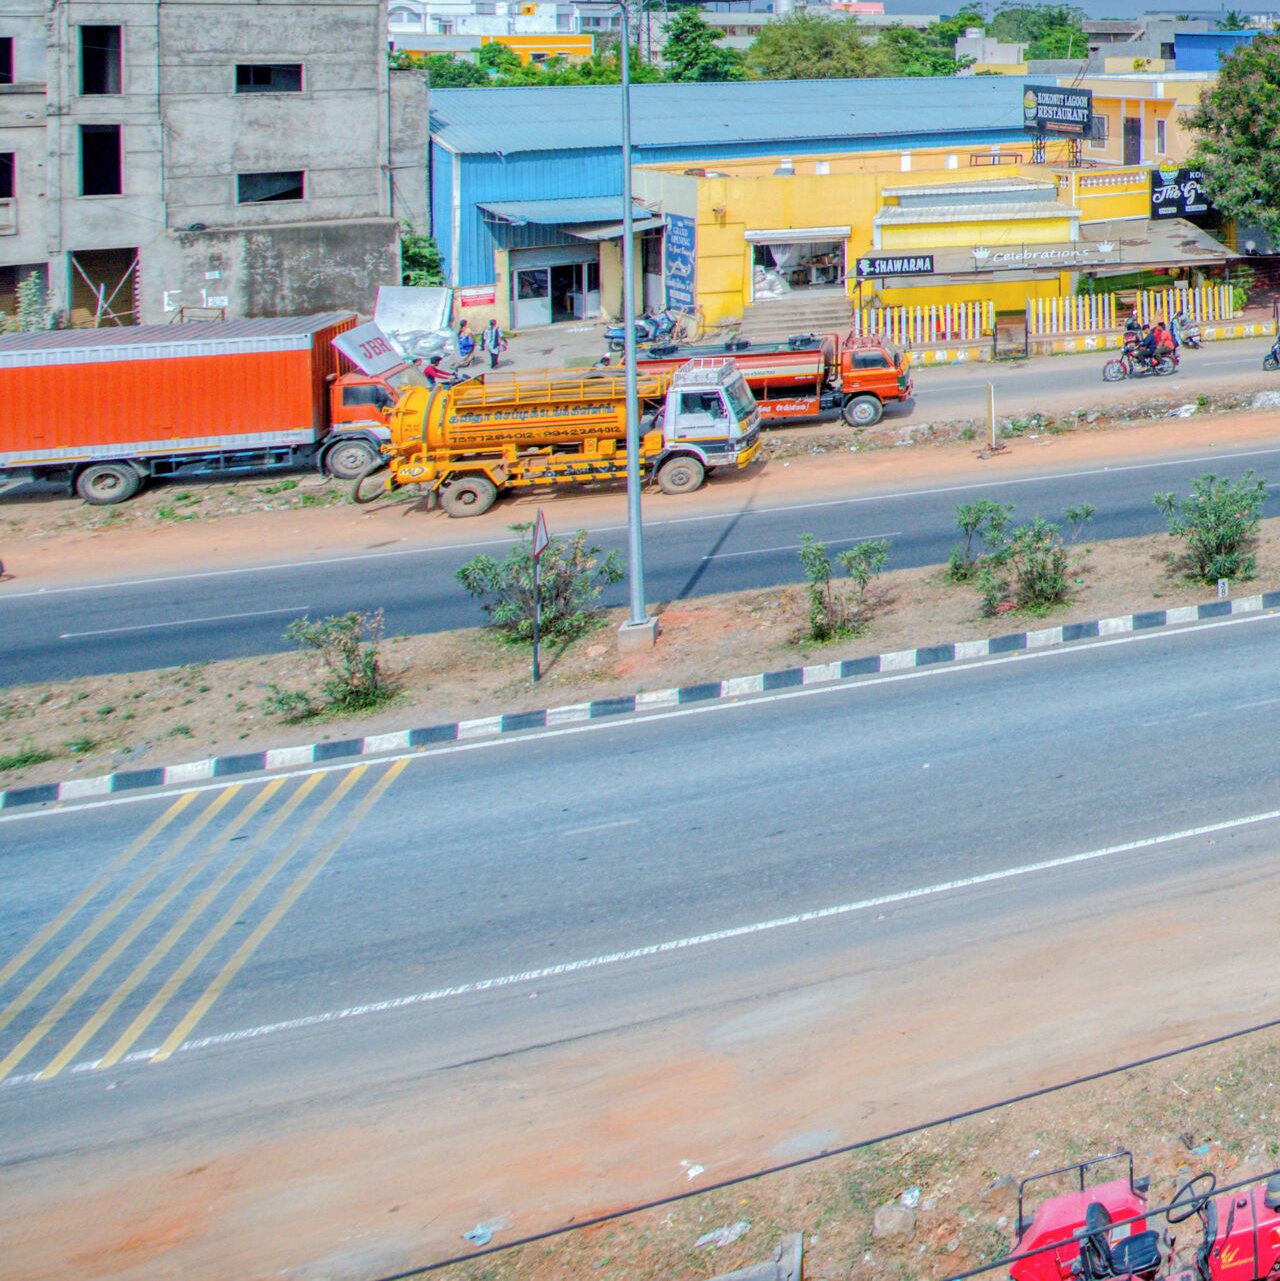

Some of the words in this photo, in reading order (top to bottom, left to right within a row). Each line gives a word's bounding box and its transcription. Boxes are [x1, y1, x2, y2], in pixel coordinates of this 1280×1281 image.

[1037, 92, 1064, 105] KOKONUT
[1064, 94, 1088, 108] LAGOON
[1037, 105, 1088, 122] RESTAURANT
[991, 247, 1090, 264] Celebrations
[873, 257, 932, 274] SHAWARMA
[358, 337, 392, 360] JBR
